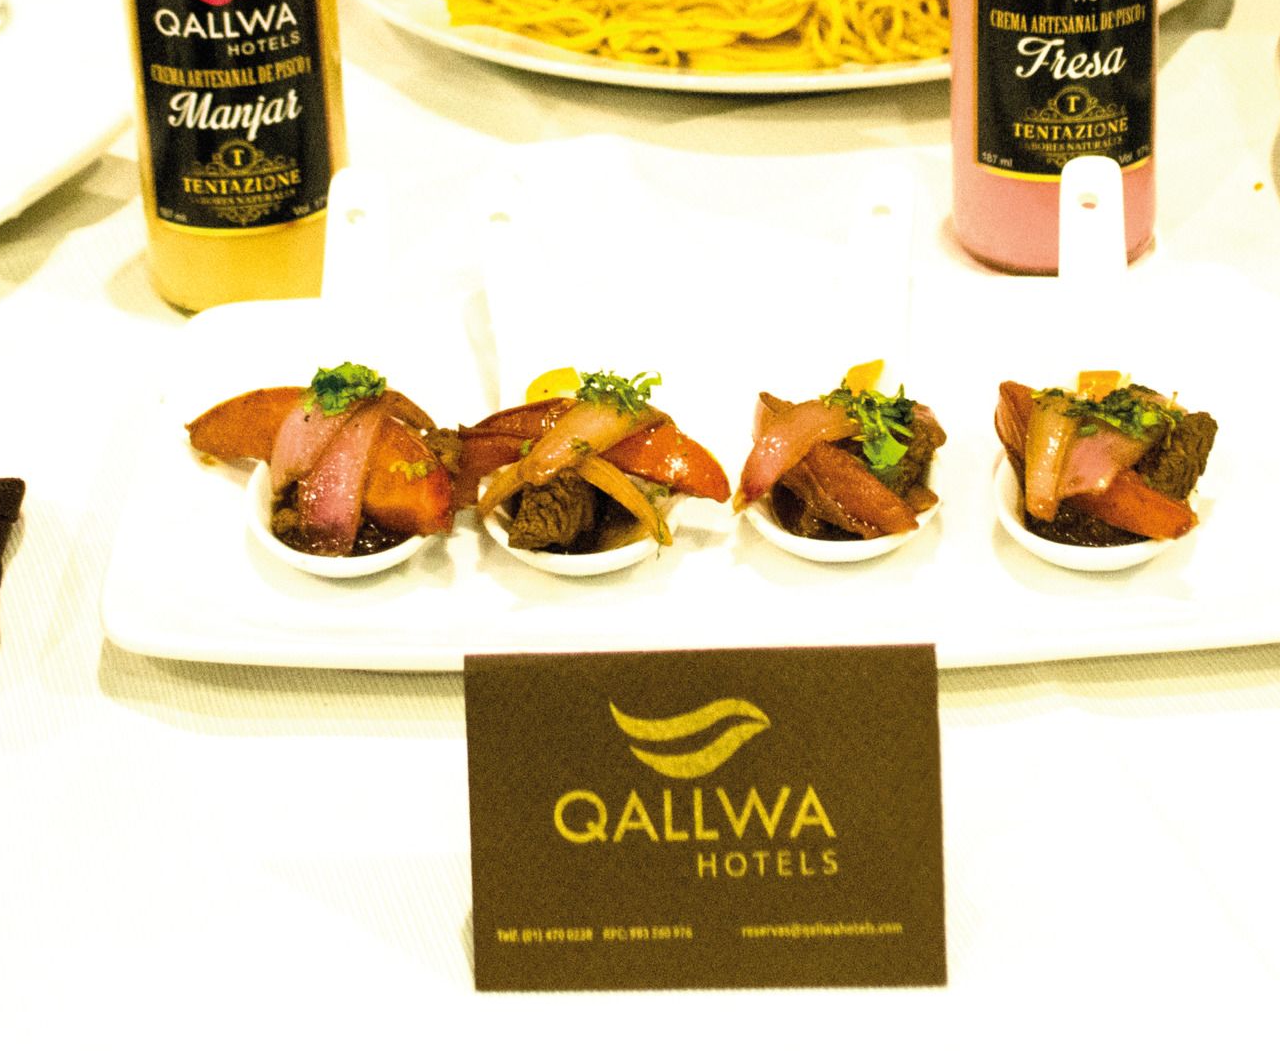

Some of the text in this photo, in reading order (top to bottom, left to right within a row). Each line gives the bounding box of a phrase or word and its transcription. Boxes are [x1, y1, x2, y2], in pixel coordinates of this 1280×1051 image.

[154, 1, 298, 40] QALLWA
[989, 8, 1028, 33] CREMA
[1030, 13, 1098, 35] ARTESANAL
[1099, 10, 1114, 32] DE
[1115, 3, 1141, 27] PISCO
[227, 31, 302, 57] HOTELS
[1015, 35, 1128, 81] Fresa
[150, 63, 186, 87] CREMA
[187, 67, 256, 89] ARTESANAL
[257, 64, 274, 85] DE
[168, 88, 303, 142] Manjar
[1067, 95, 1081, 113] T
[1013, 116, 1129, 141] TENTAZIONE
[231, 149, 245, 167] T
[181, 168, 302, 195] TENTAZIONE
[553, 784, 837, 844] QALLWA
[696, 849, 840, 879] HOTELS
